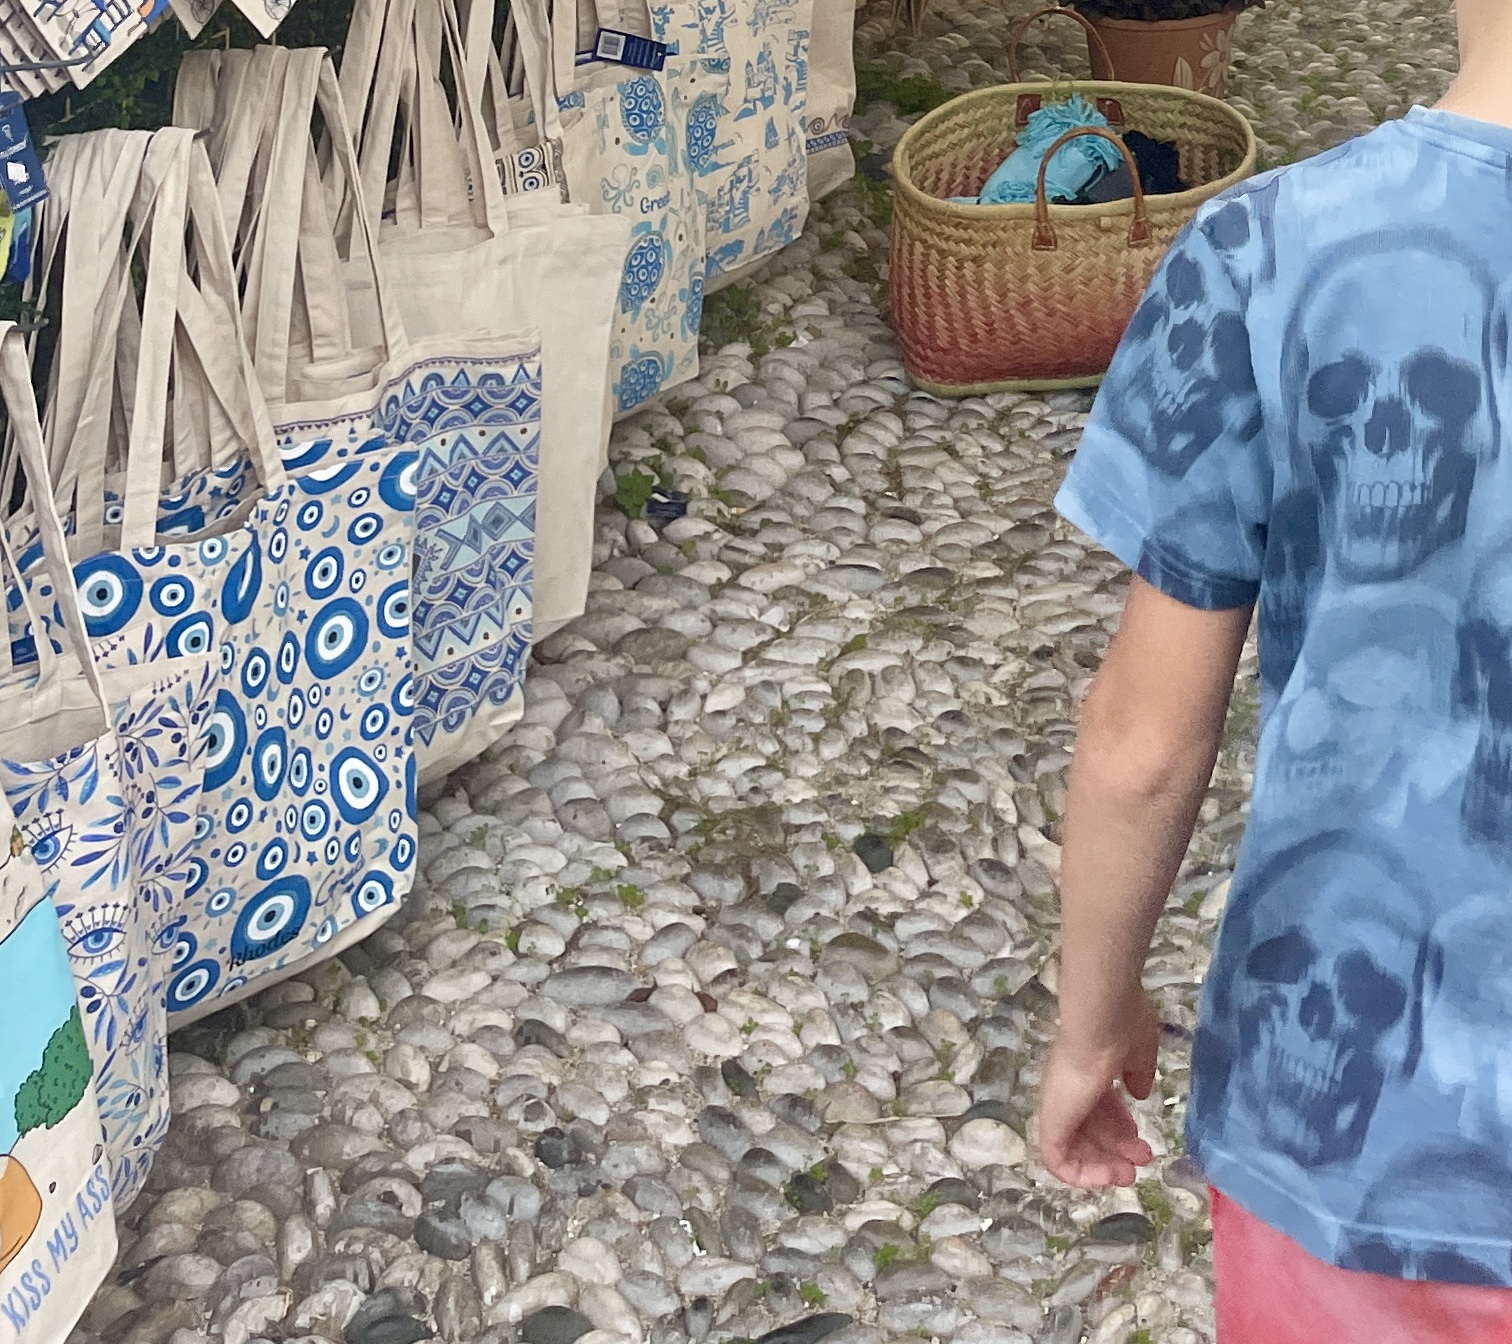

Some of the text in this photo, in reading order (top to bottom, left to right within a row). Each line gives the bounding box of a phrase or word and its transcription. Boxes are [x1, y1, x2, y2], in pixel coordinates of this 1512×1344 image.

[228, 926, 300, 972] Rhodes
[0, 1164, 111, 1336] KISS MY ASS
